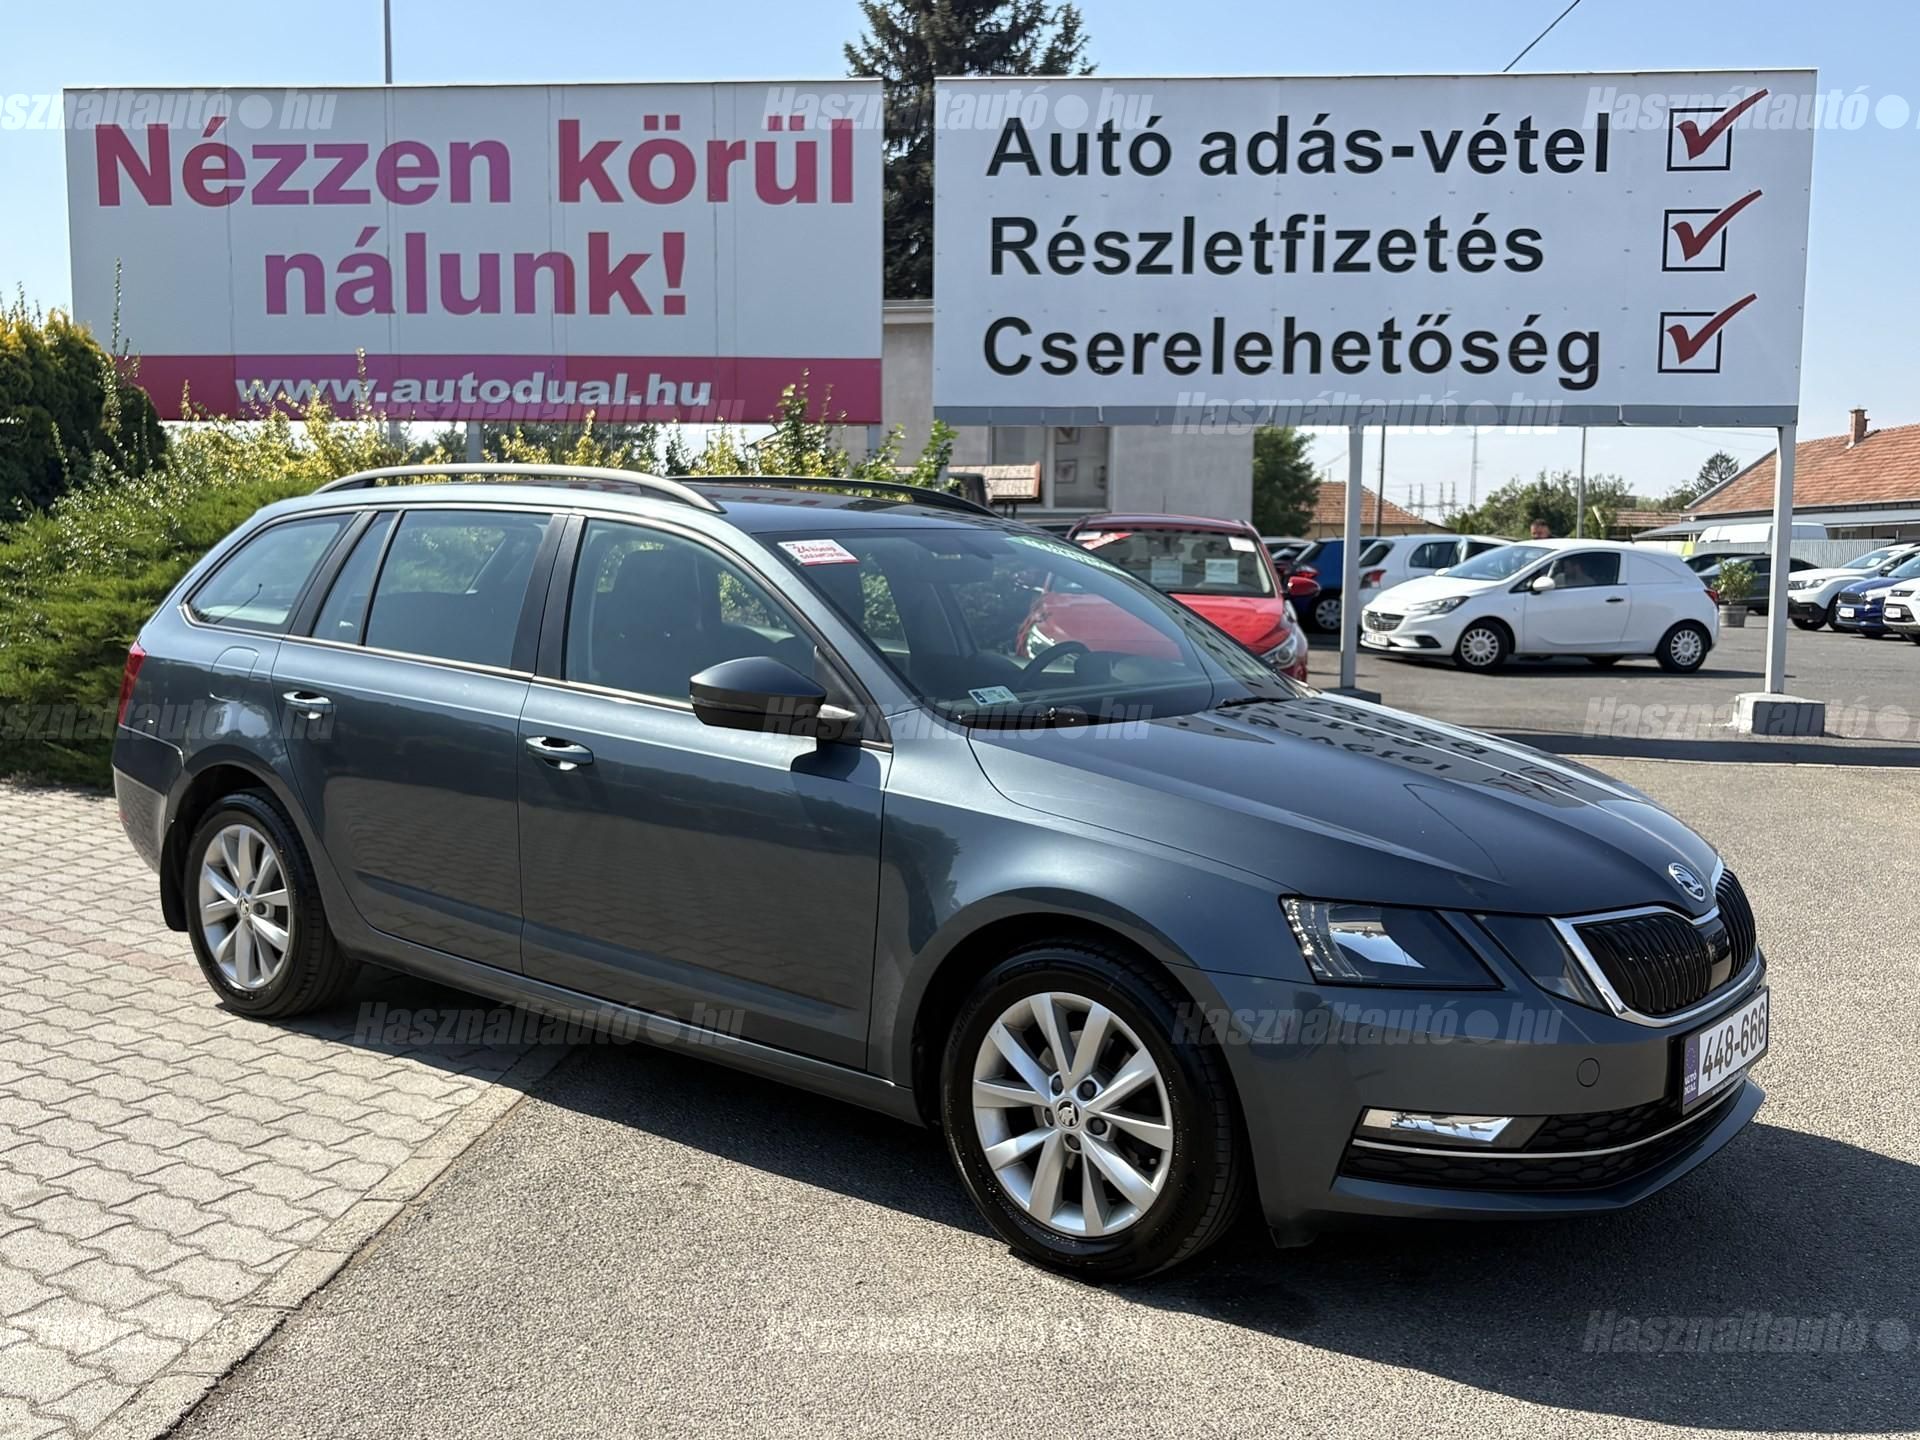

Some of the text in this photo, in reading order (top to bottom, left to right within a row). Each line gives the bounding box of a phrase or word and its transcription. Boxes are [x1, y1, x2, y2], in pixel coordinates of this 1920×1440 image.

[95, 114, 854, 207] Nézzen körül
[986, 111, 1608, 176] Autó adás-vétel
[265, 226, 686, 315] nálunk!
[991, 212, 1543, 276] Részletfizetés
[235, 370, 713, 407] www.autodual.hu
[983, 313, 1600, 390] Cserelehetőség
[1702, 1001, 1766, 1082] 448-666
